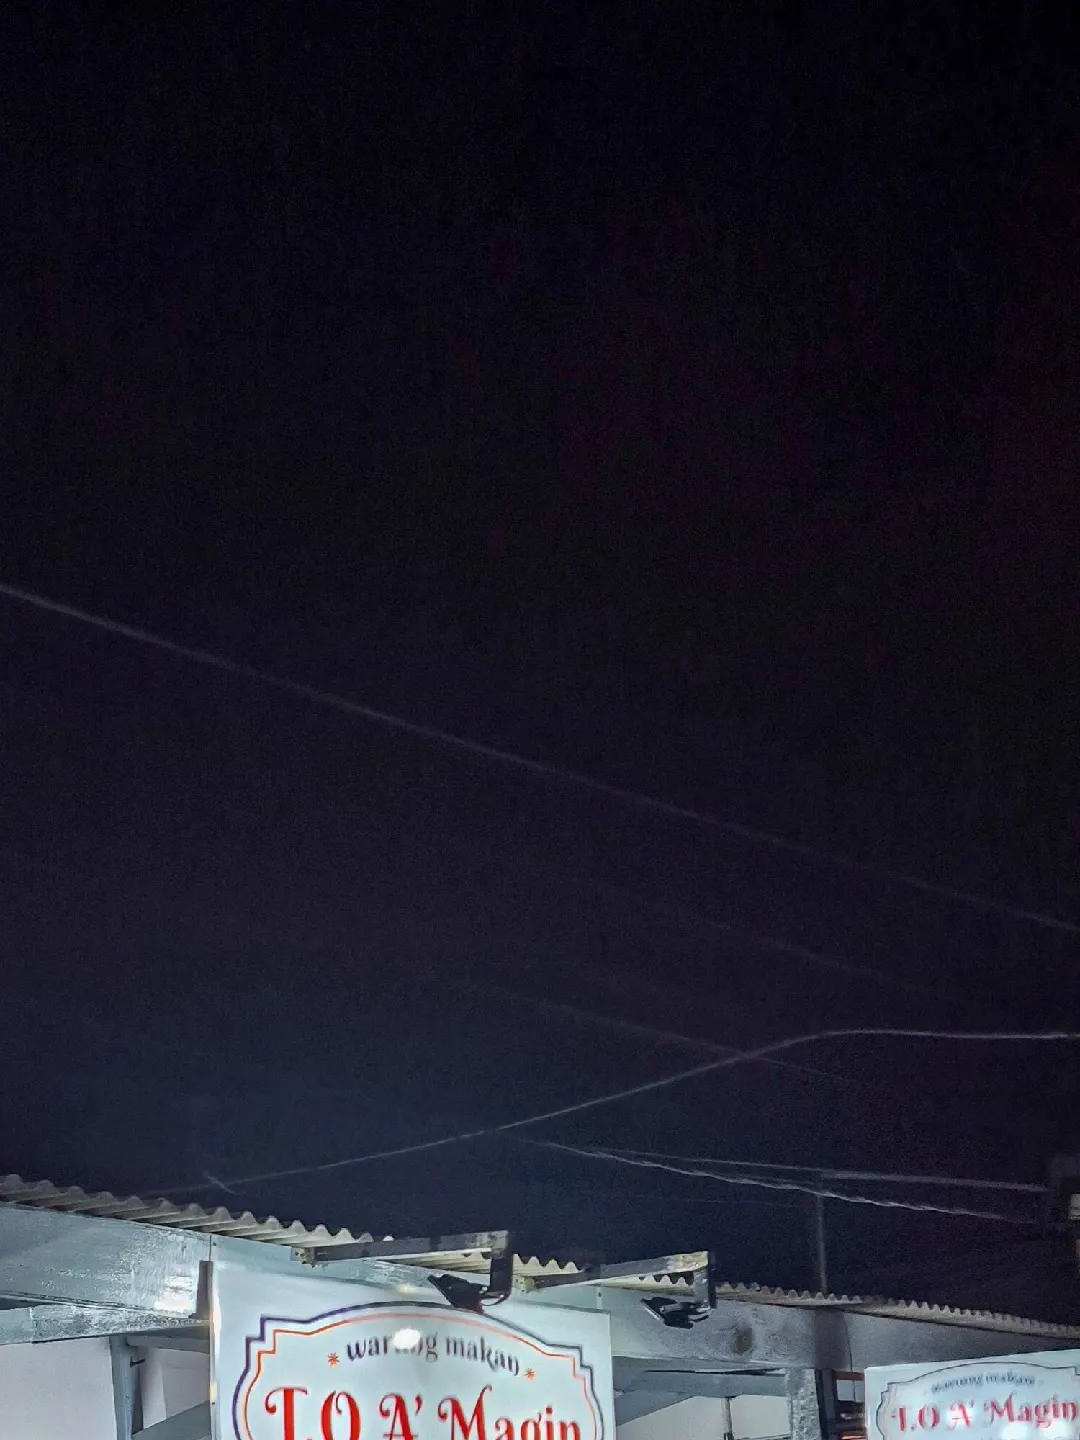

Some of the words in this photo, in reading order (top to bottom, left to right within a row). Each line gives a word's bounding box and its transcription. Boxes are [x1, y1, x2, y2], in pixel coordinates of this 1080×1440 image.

[346, 1332, 438, 1363] warg
[446, 1336, 520, 1377] makan
[983, 1391, 1078, 1429] Magin
